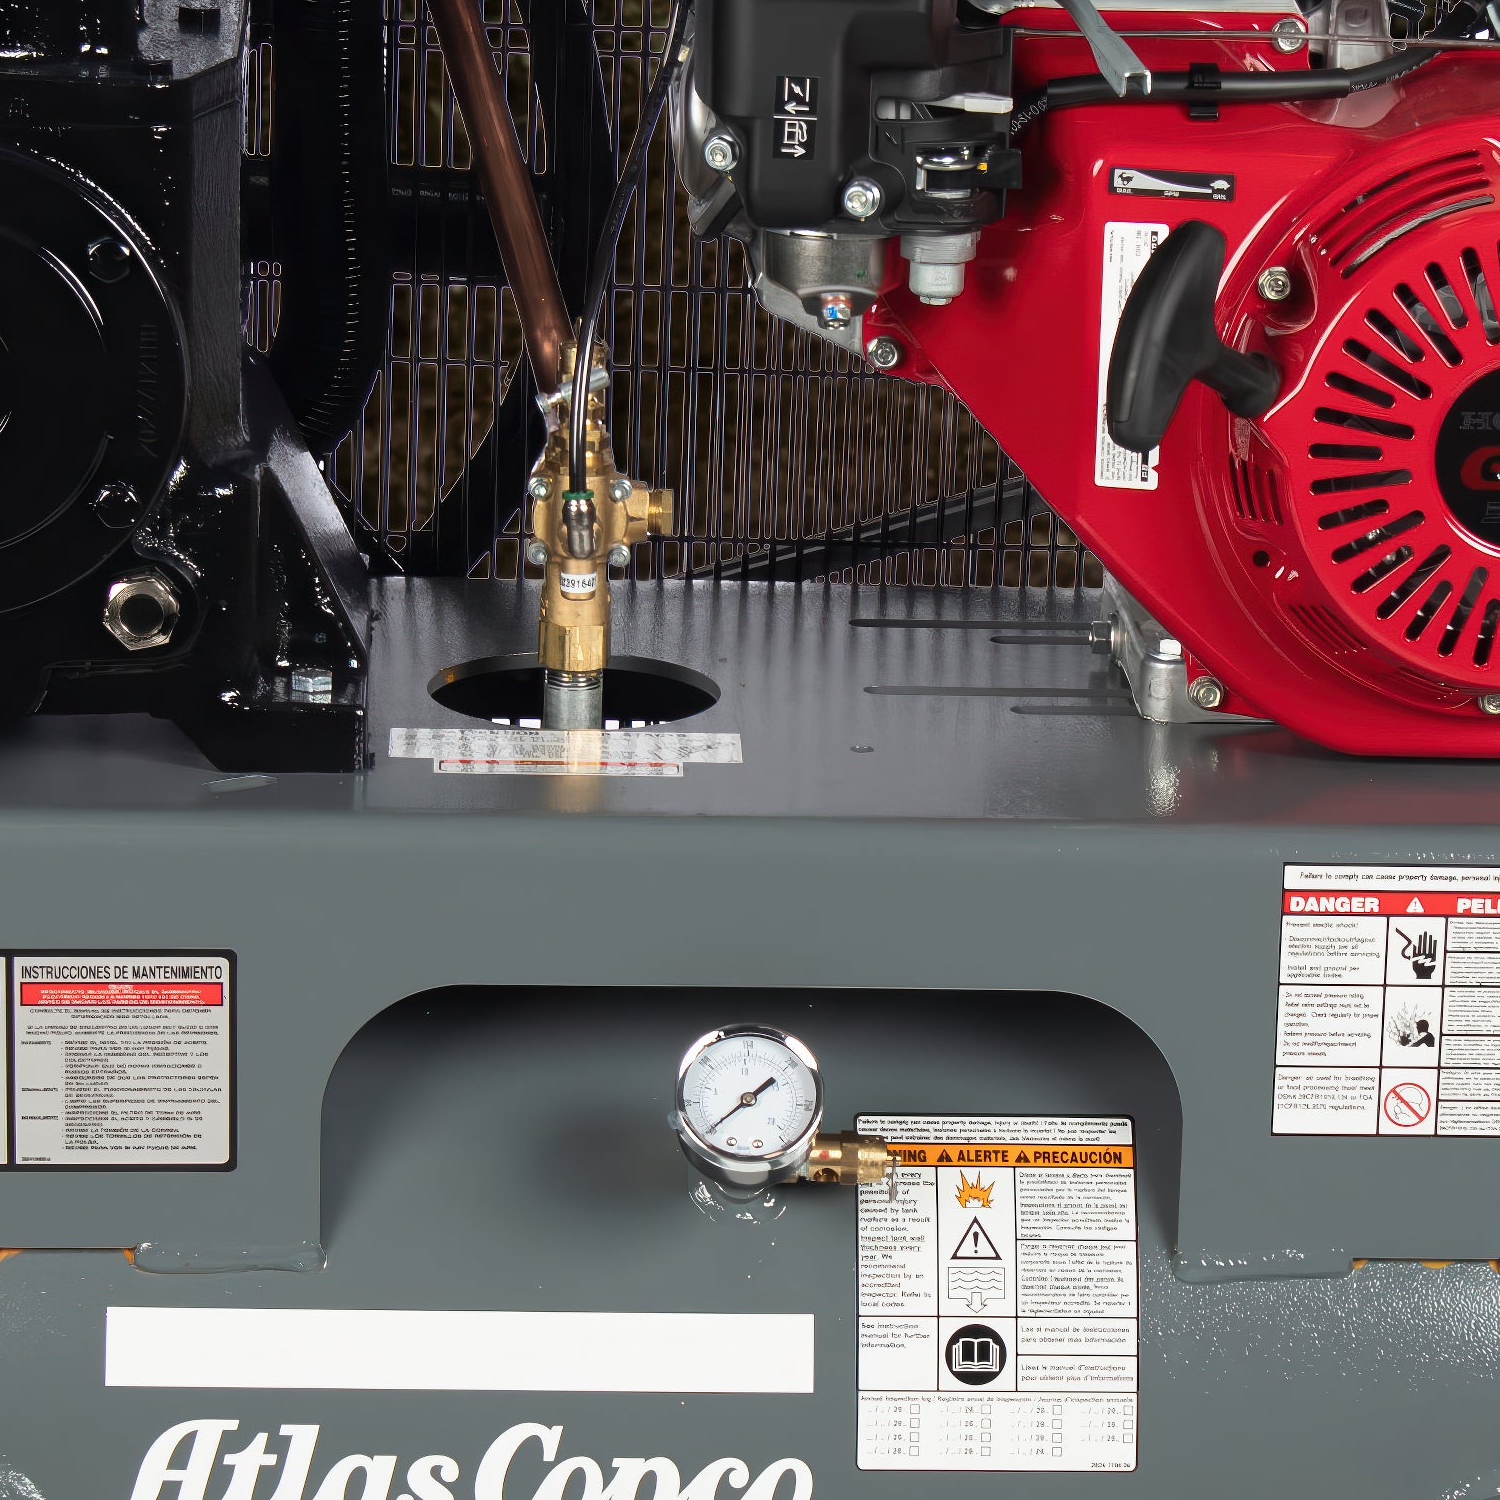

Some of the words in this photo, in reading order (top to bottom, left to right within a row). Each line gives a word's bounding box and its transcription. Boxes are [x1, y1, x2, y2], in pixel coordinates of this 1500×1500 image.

[1335, 873, 1358, 882] comply
[1290, 896, 1379, 913] DANGER
[22, 966, 110, 979] INSTRUCCIONES
[114, 966, 128, 979] DE
[133, 966, 222, 979] MANTENIMIENTO
[958, 1150, 1008, 1162] ALERTE
[1034, 1149, 1122, 1163] PRECAUCIÓN
